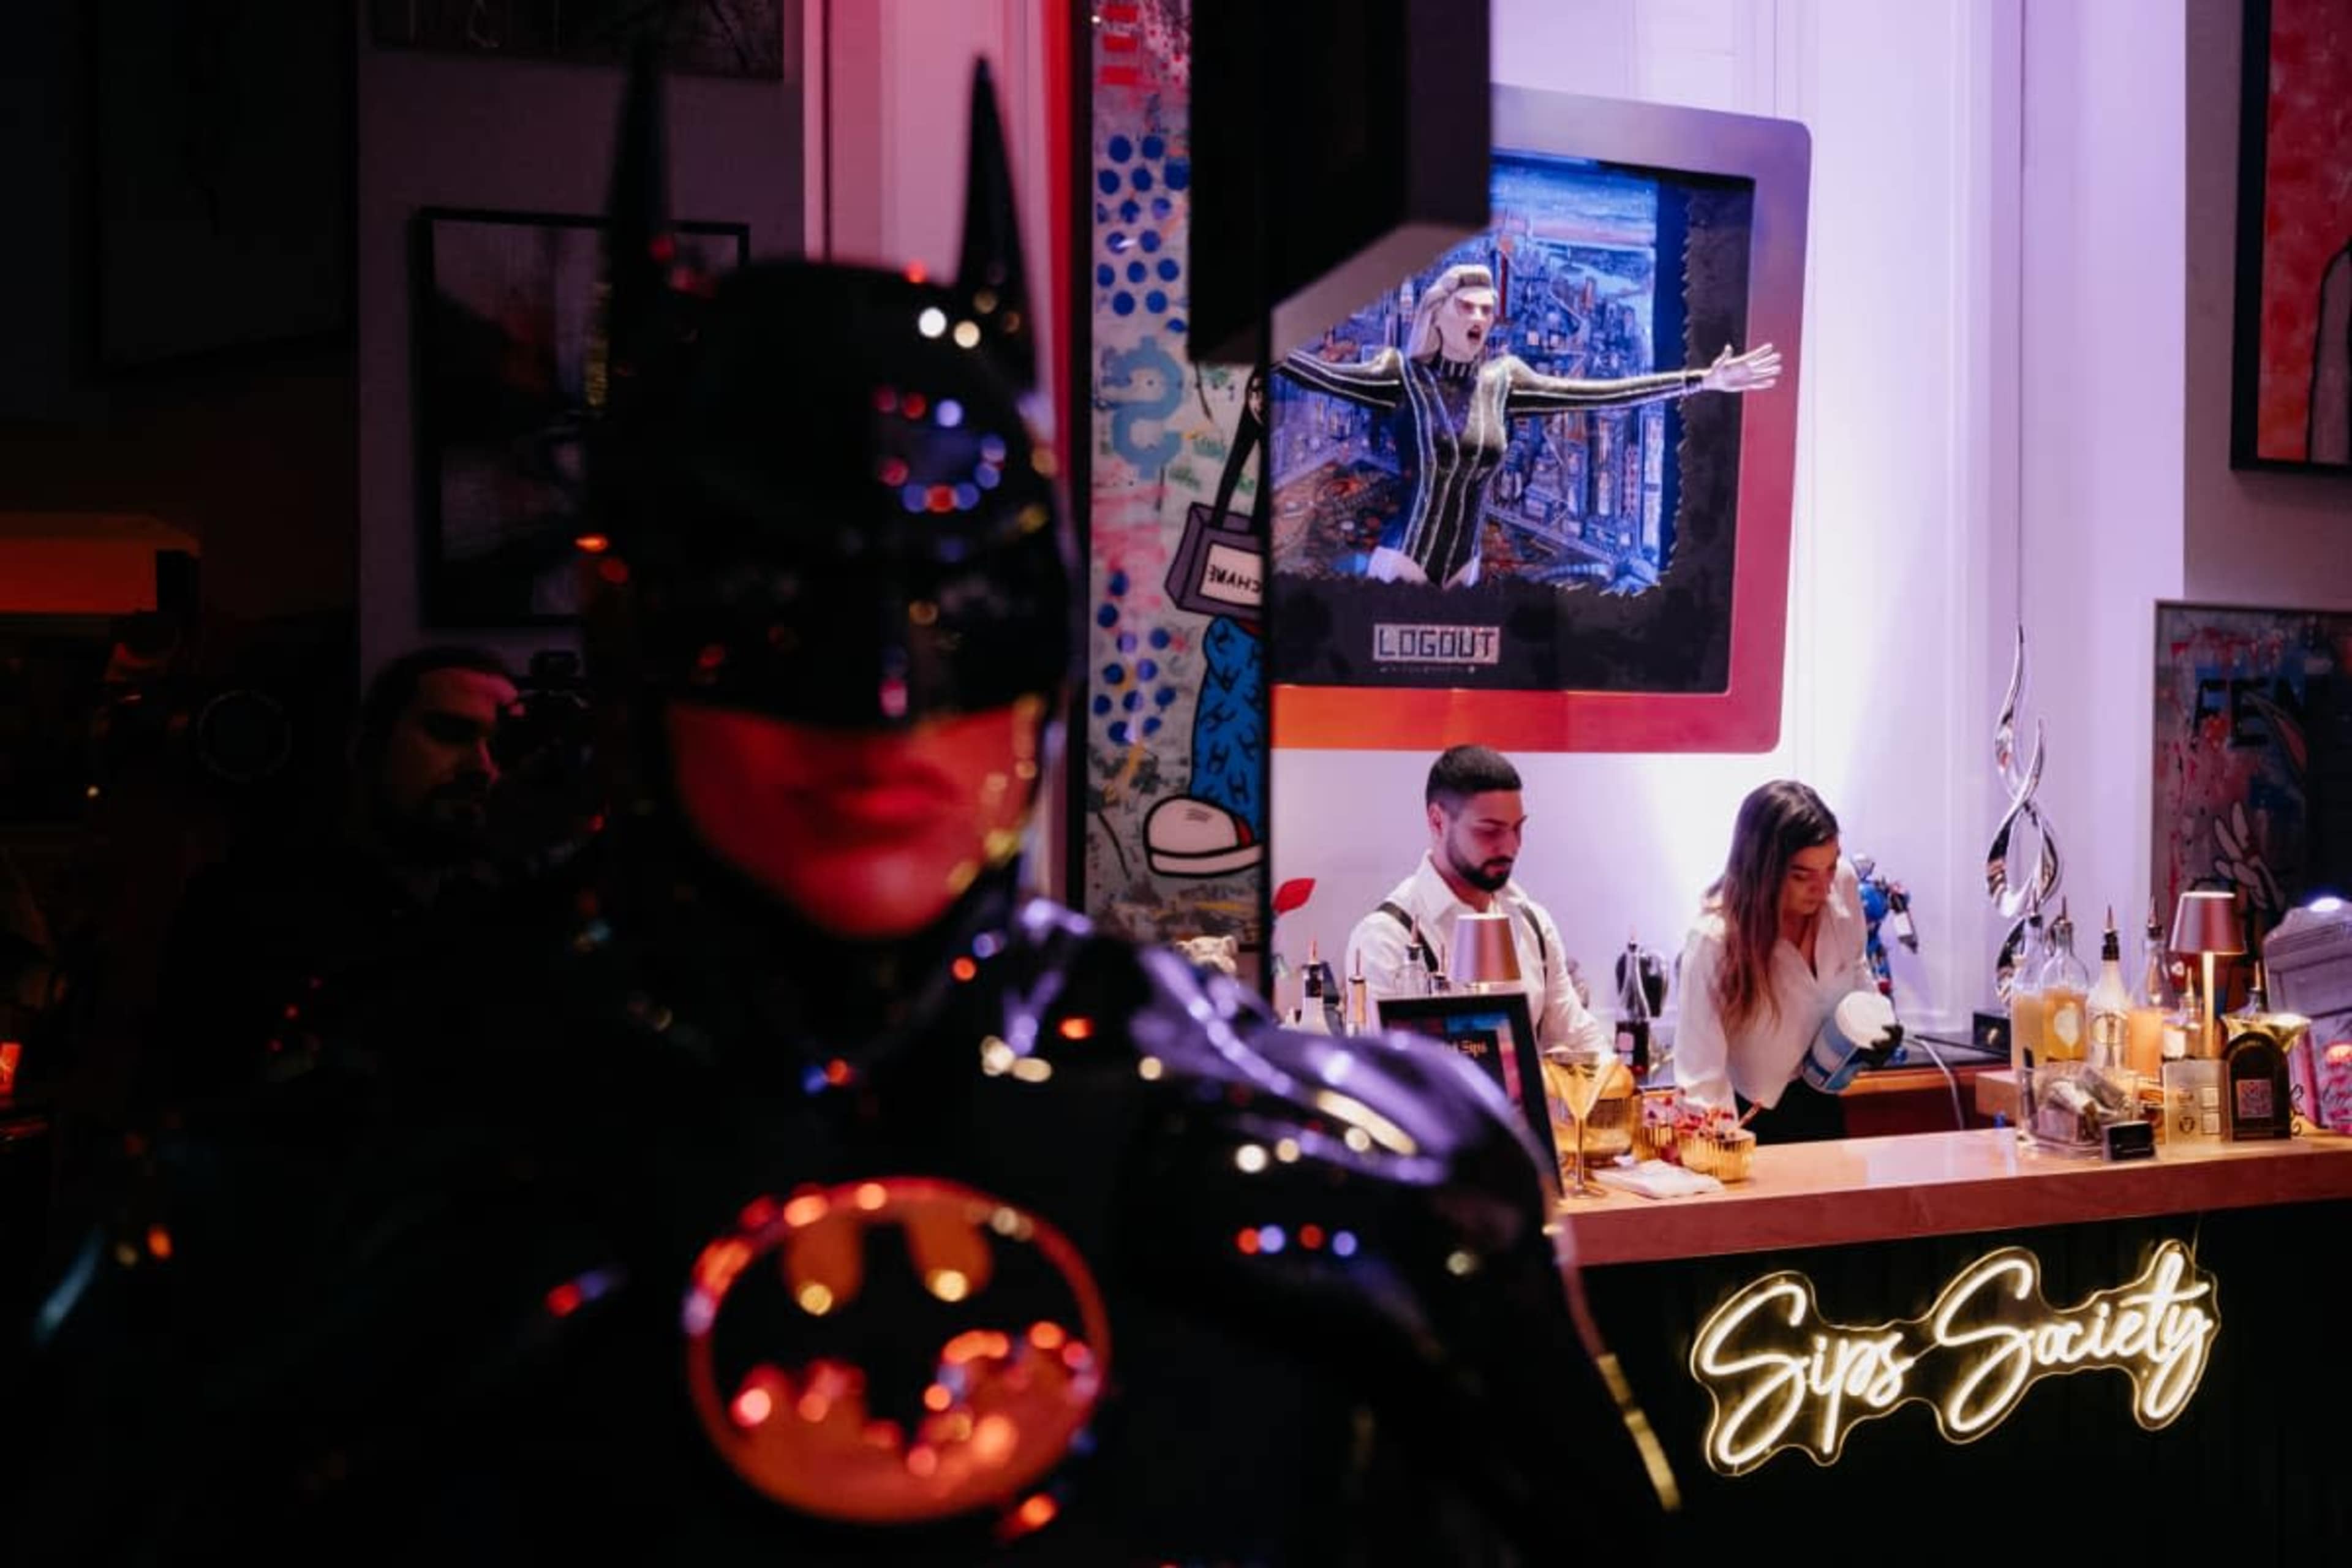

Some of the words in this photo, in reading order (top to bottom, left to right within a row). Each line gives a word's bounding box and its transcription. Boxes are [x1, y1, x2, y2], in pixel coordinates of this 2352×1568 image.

[1379, 627, 1495, 658] LOGOUT
[1700, 1281, 1916, 1468] Sips
[1933, 1243, 2212, 1432] Society
